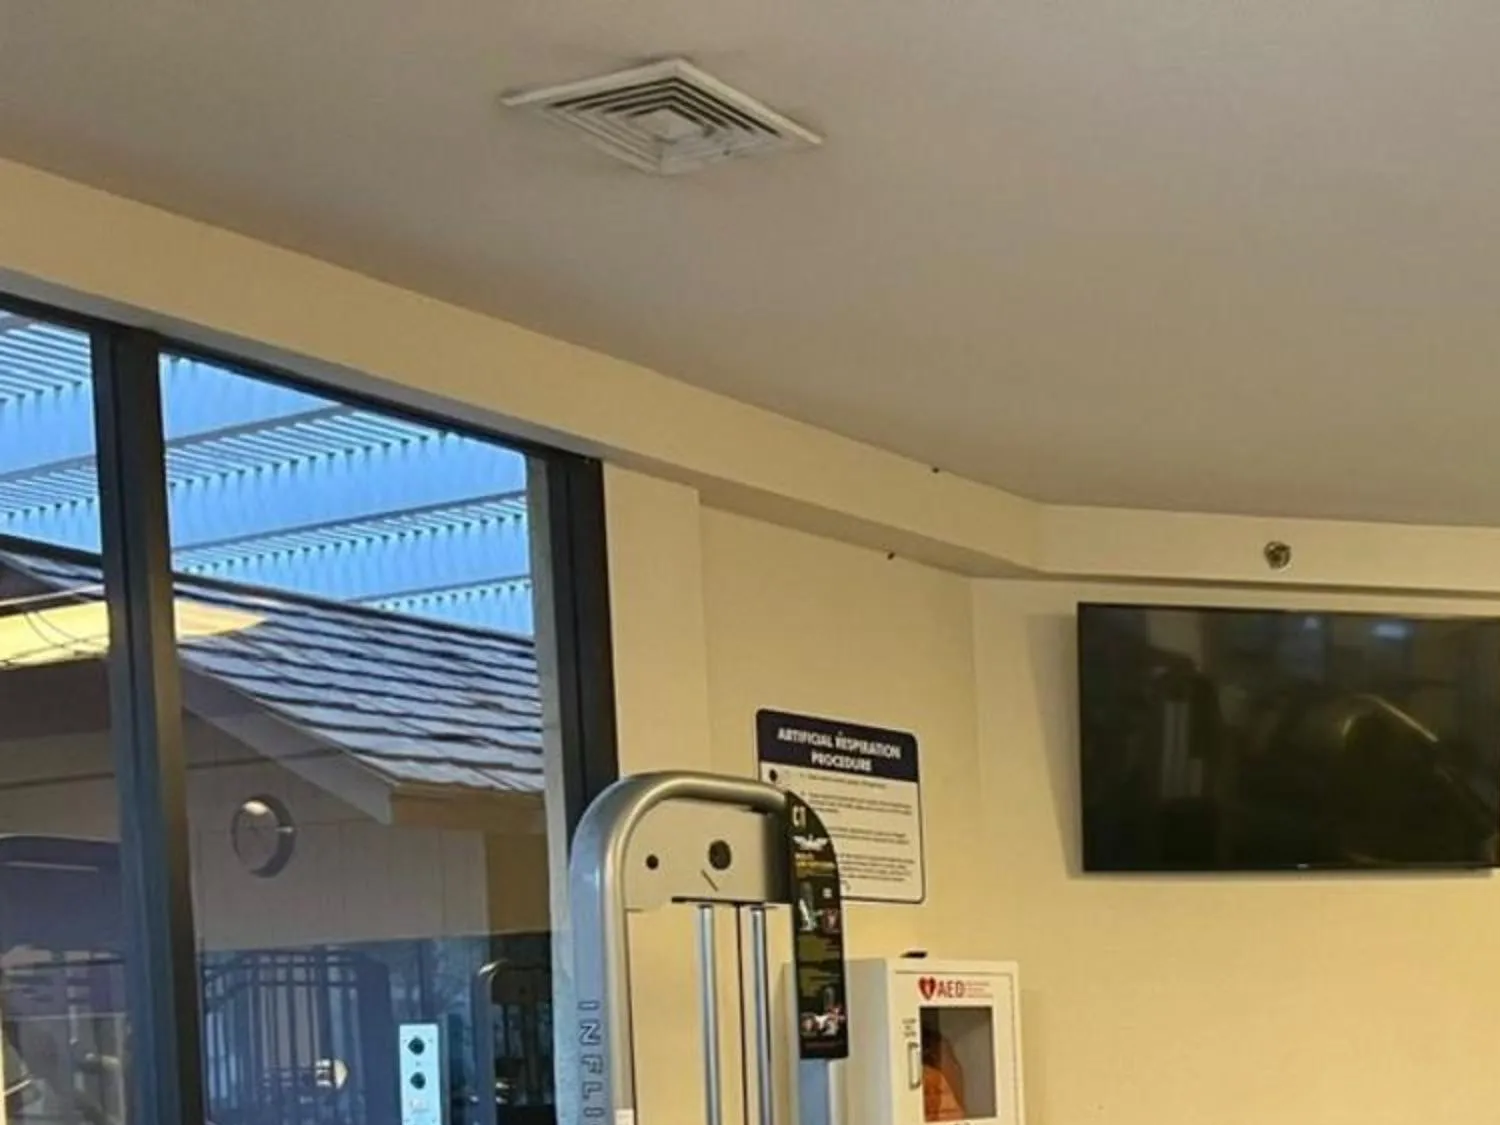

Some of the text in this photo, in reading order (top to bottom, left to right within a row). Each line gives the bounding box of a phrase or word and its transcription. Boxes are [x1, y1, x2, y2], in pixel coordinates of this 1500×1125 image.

[777, 727, 901, 760] ARTIFICIAL RESPIRATION
[811, 750, 873, 773] PROCEDURE
[937, 980, 965, 998] AED
